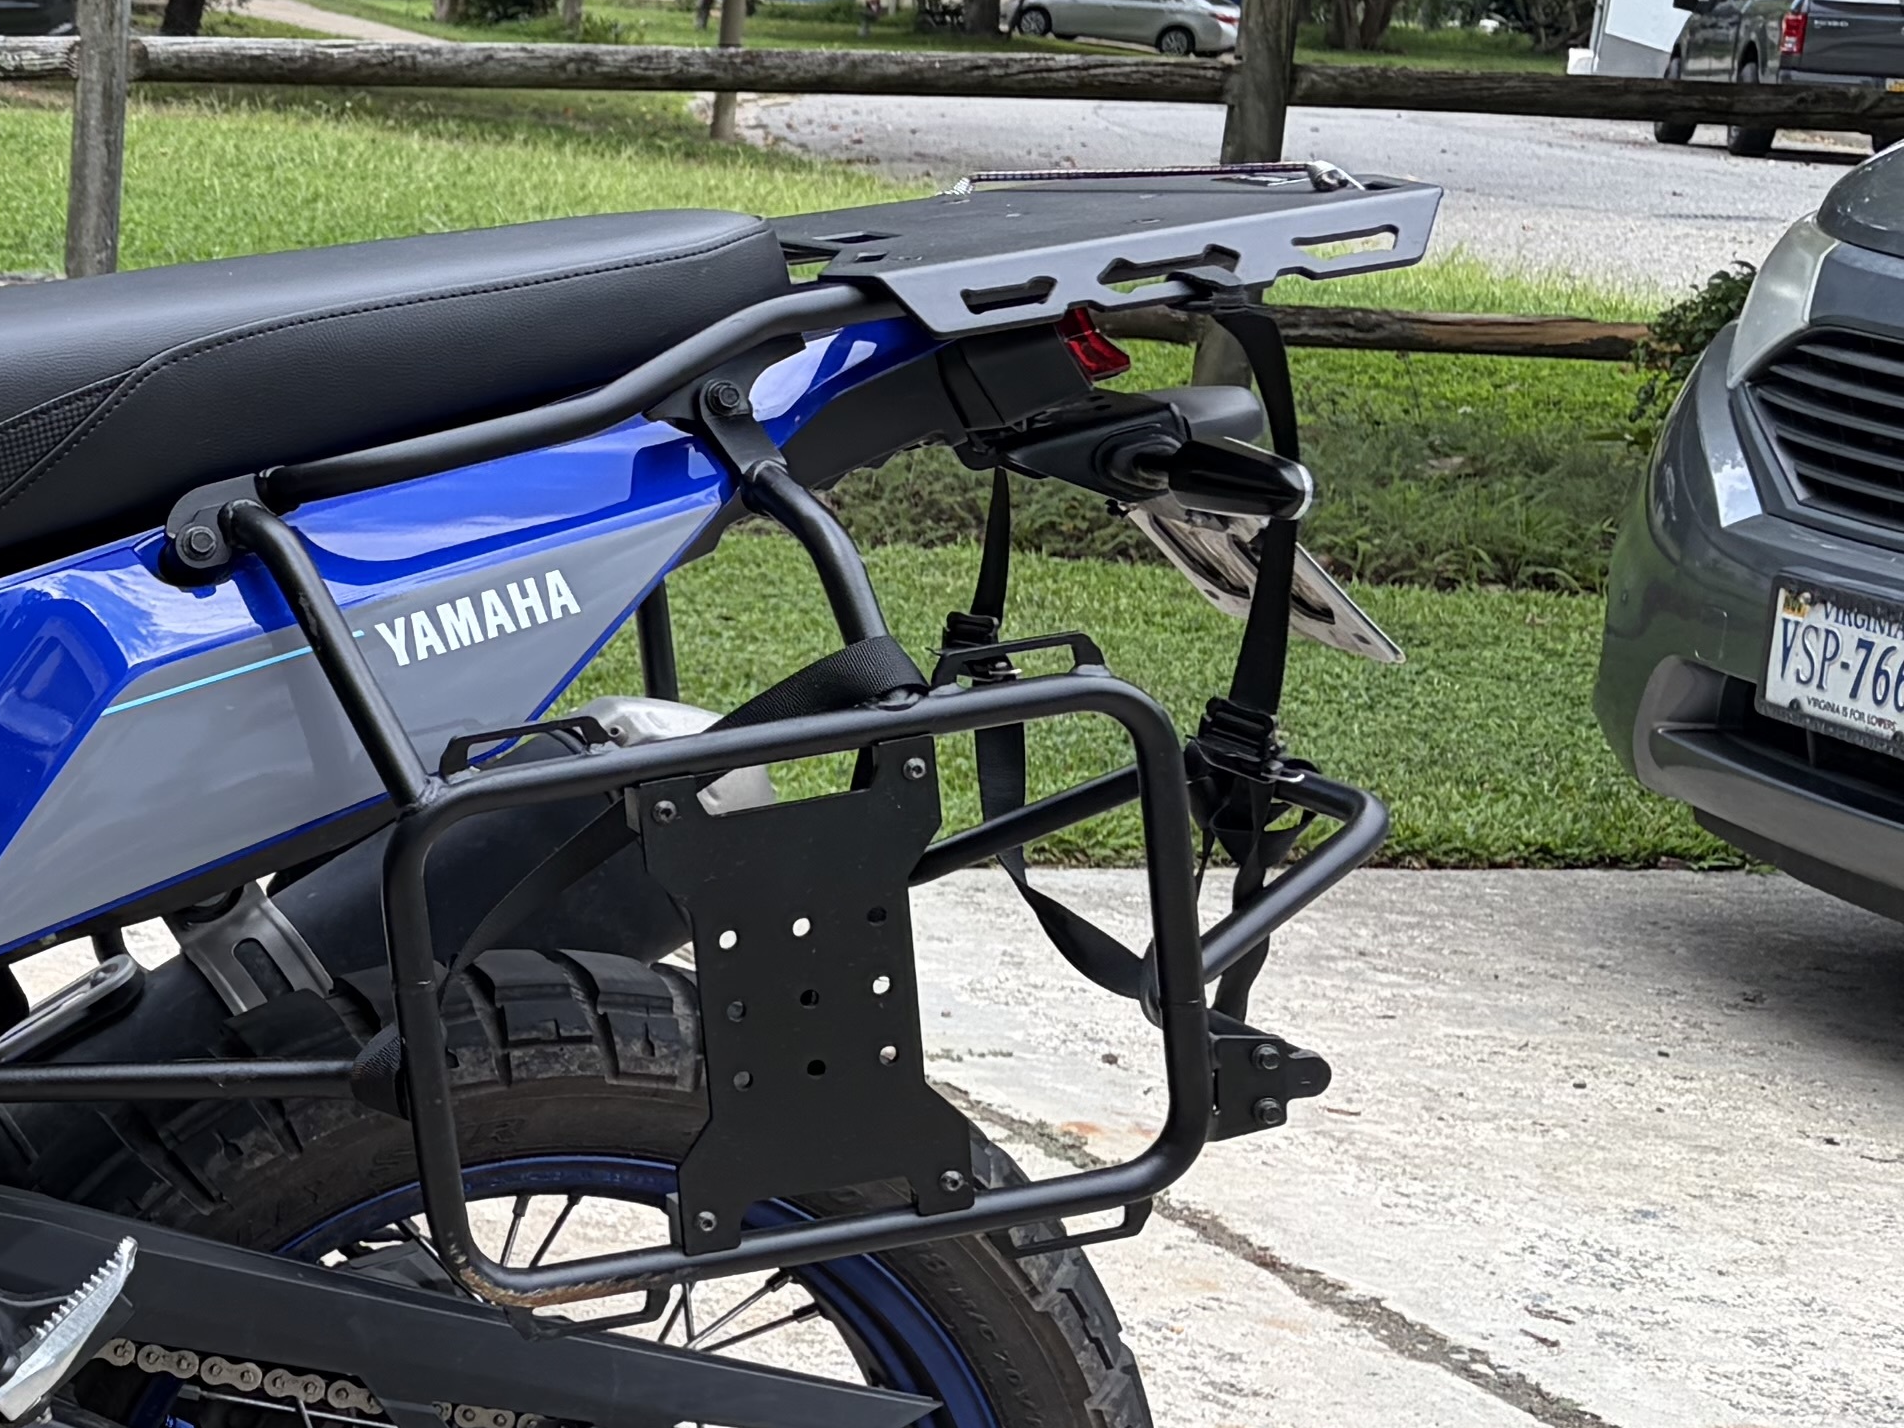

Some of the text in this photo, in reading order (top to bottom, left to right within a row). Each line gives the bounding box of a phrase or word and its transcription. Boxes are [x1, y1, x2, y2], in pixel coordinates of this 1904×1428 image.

[374, 569, 581, 666] YAMAHA
[1806, 695, 1841, 714] VIRGINIA
[1849, 708, 1866, 723] FOR
